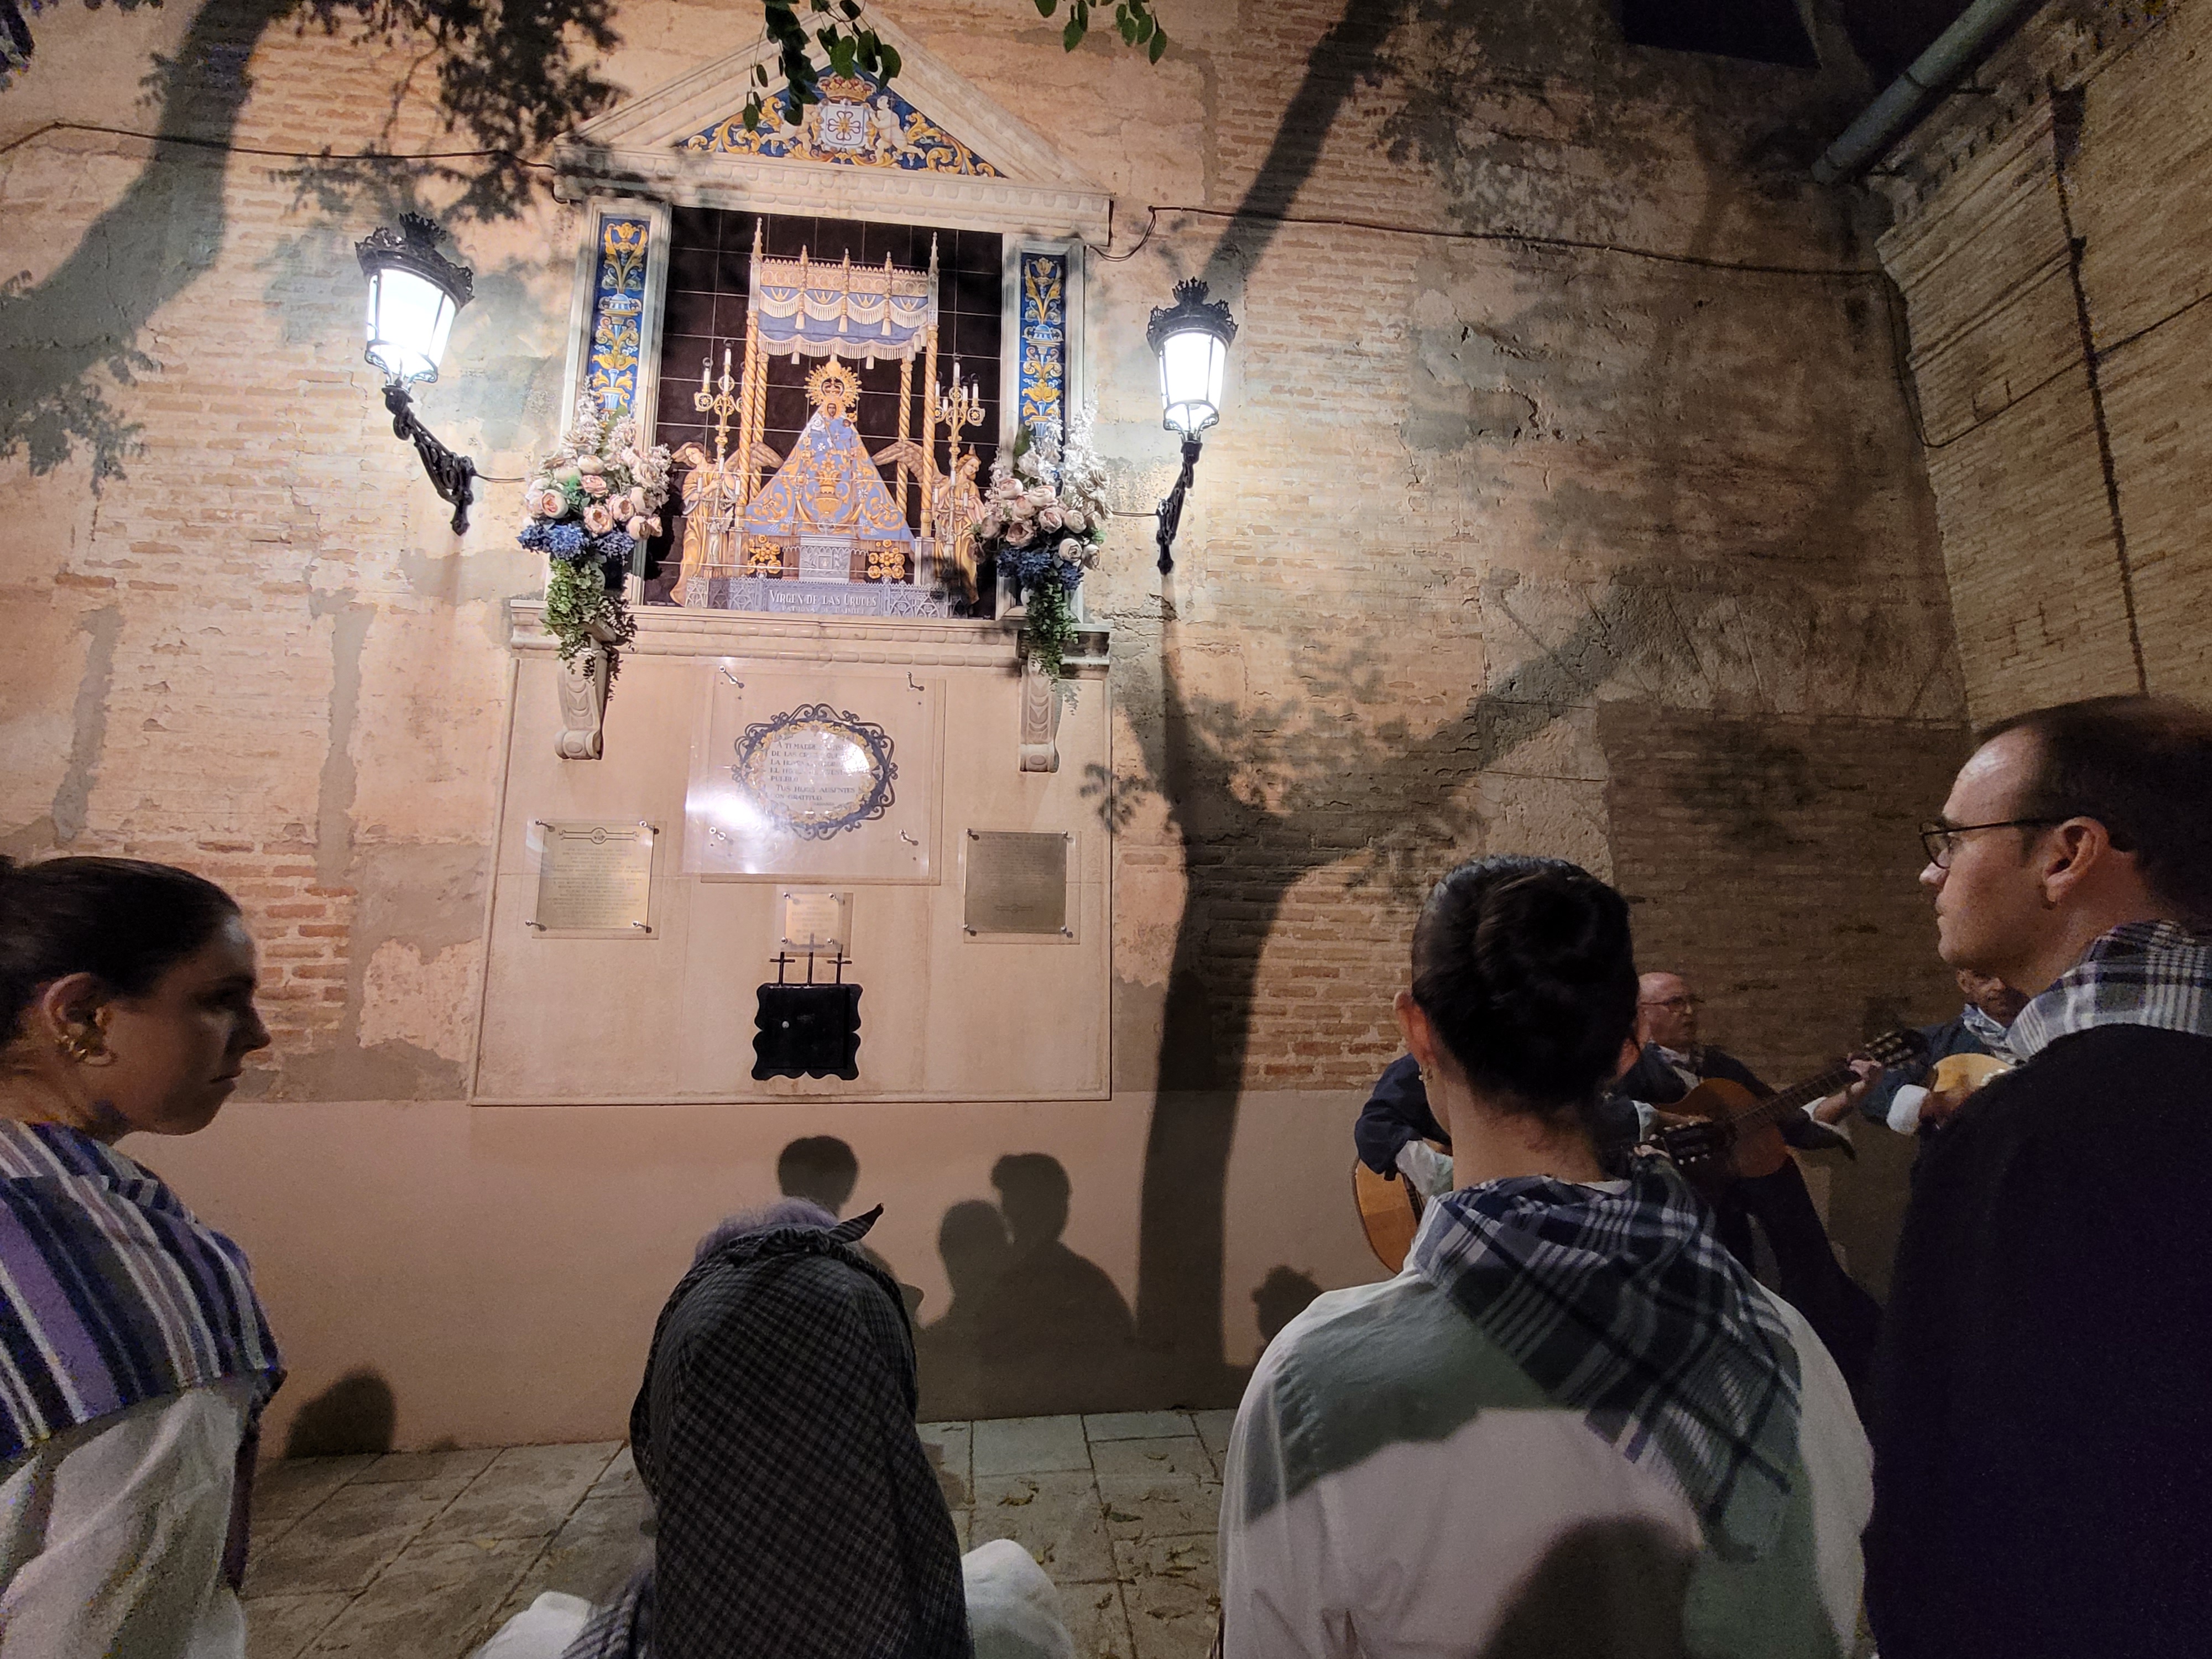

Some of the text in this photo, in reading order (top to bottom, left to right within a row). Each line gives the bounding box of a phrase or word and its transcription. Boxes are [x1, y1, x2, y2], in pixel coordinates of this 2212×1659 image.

[769, 589, 877, 607] VIRGEN DE LAS CRUCES
